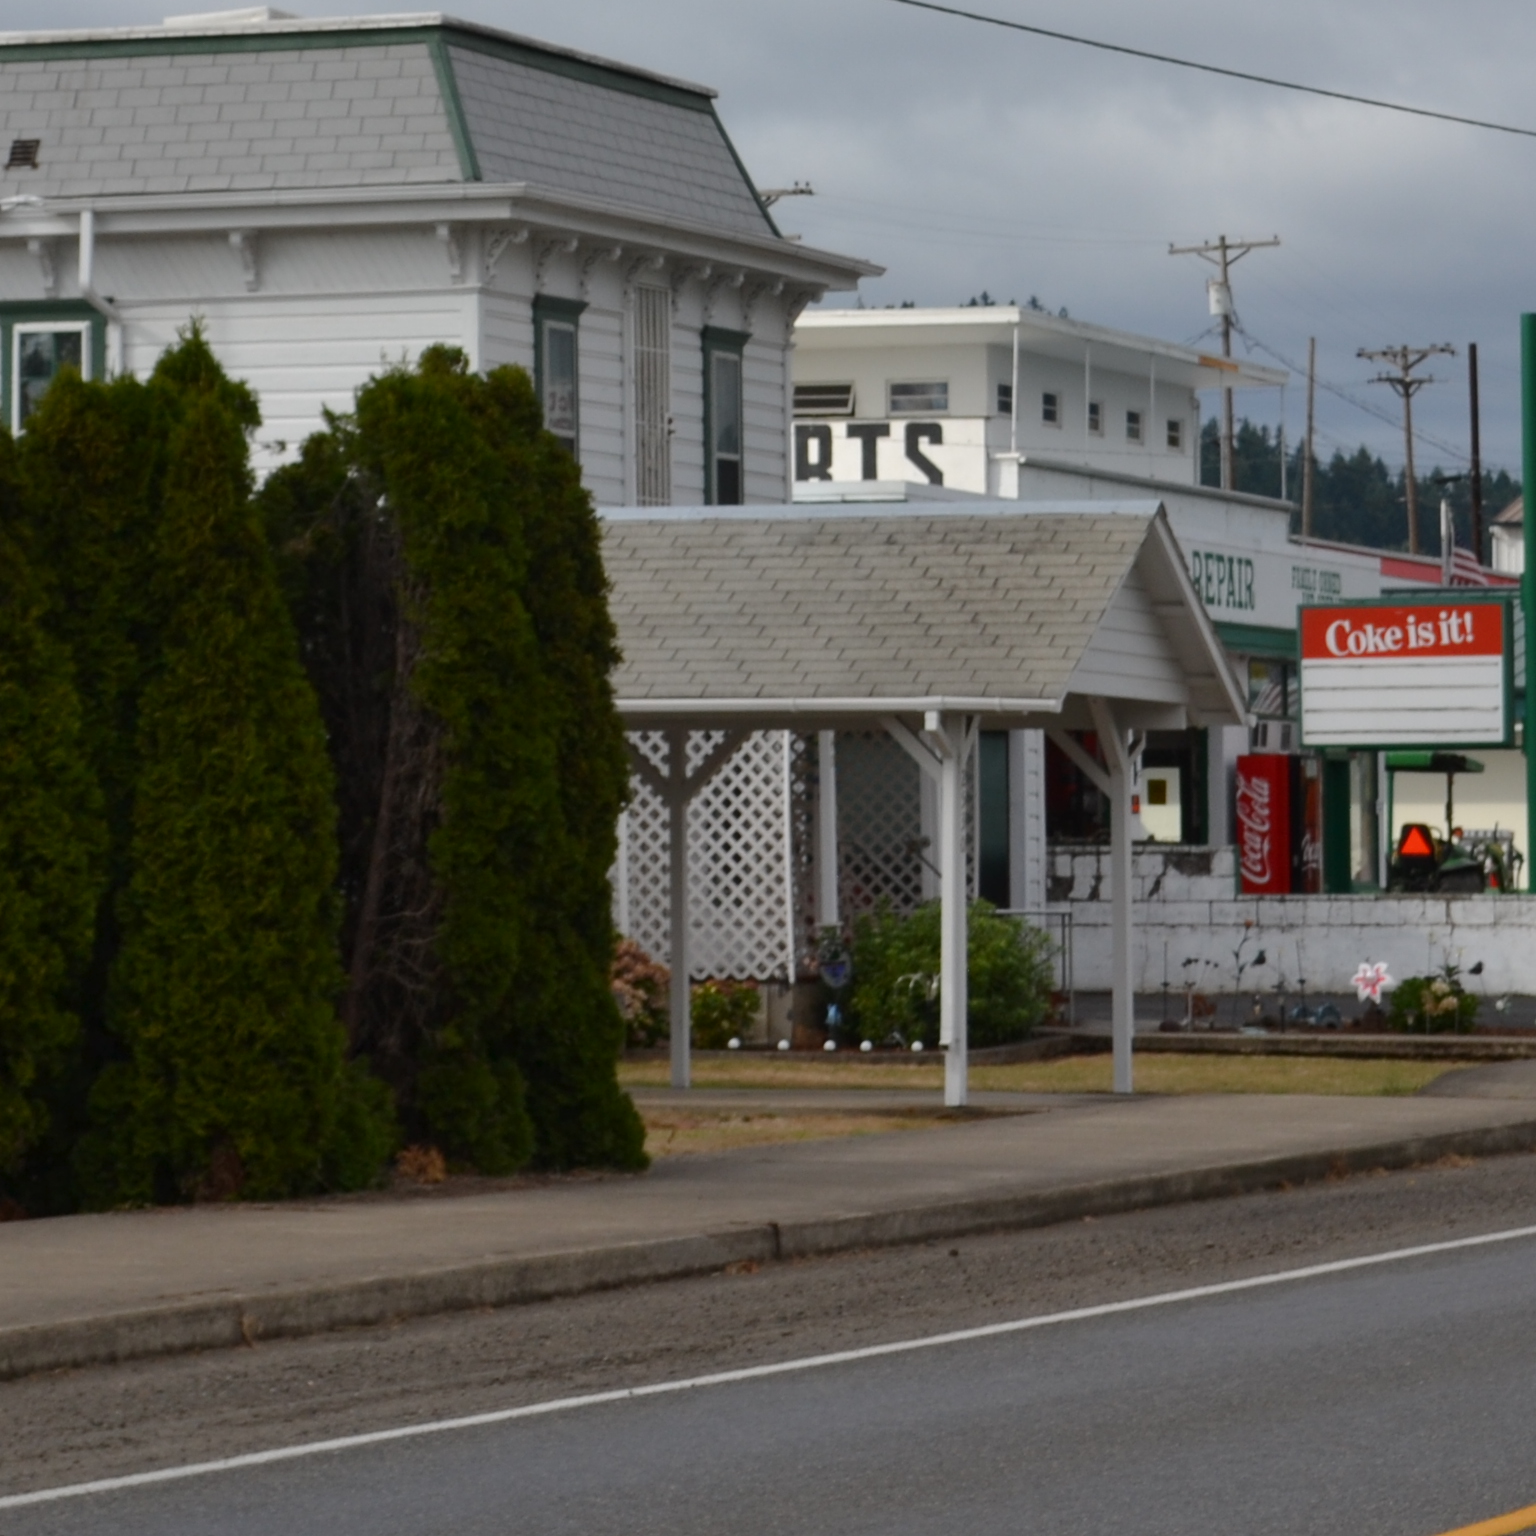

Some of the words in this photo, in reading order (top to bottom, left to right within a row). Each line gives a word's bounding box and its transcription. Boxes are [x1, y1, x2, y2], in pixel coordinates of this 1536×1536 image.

[795, 422, 943, 487] RTS
[1193, 551, 1255, 610] REPAIR
[1325, 620, 1403, 656] Coke
[1406, 615, 1436, 649] is
[1439, 611, 1474, 645] it!
